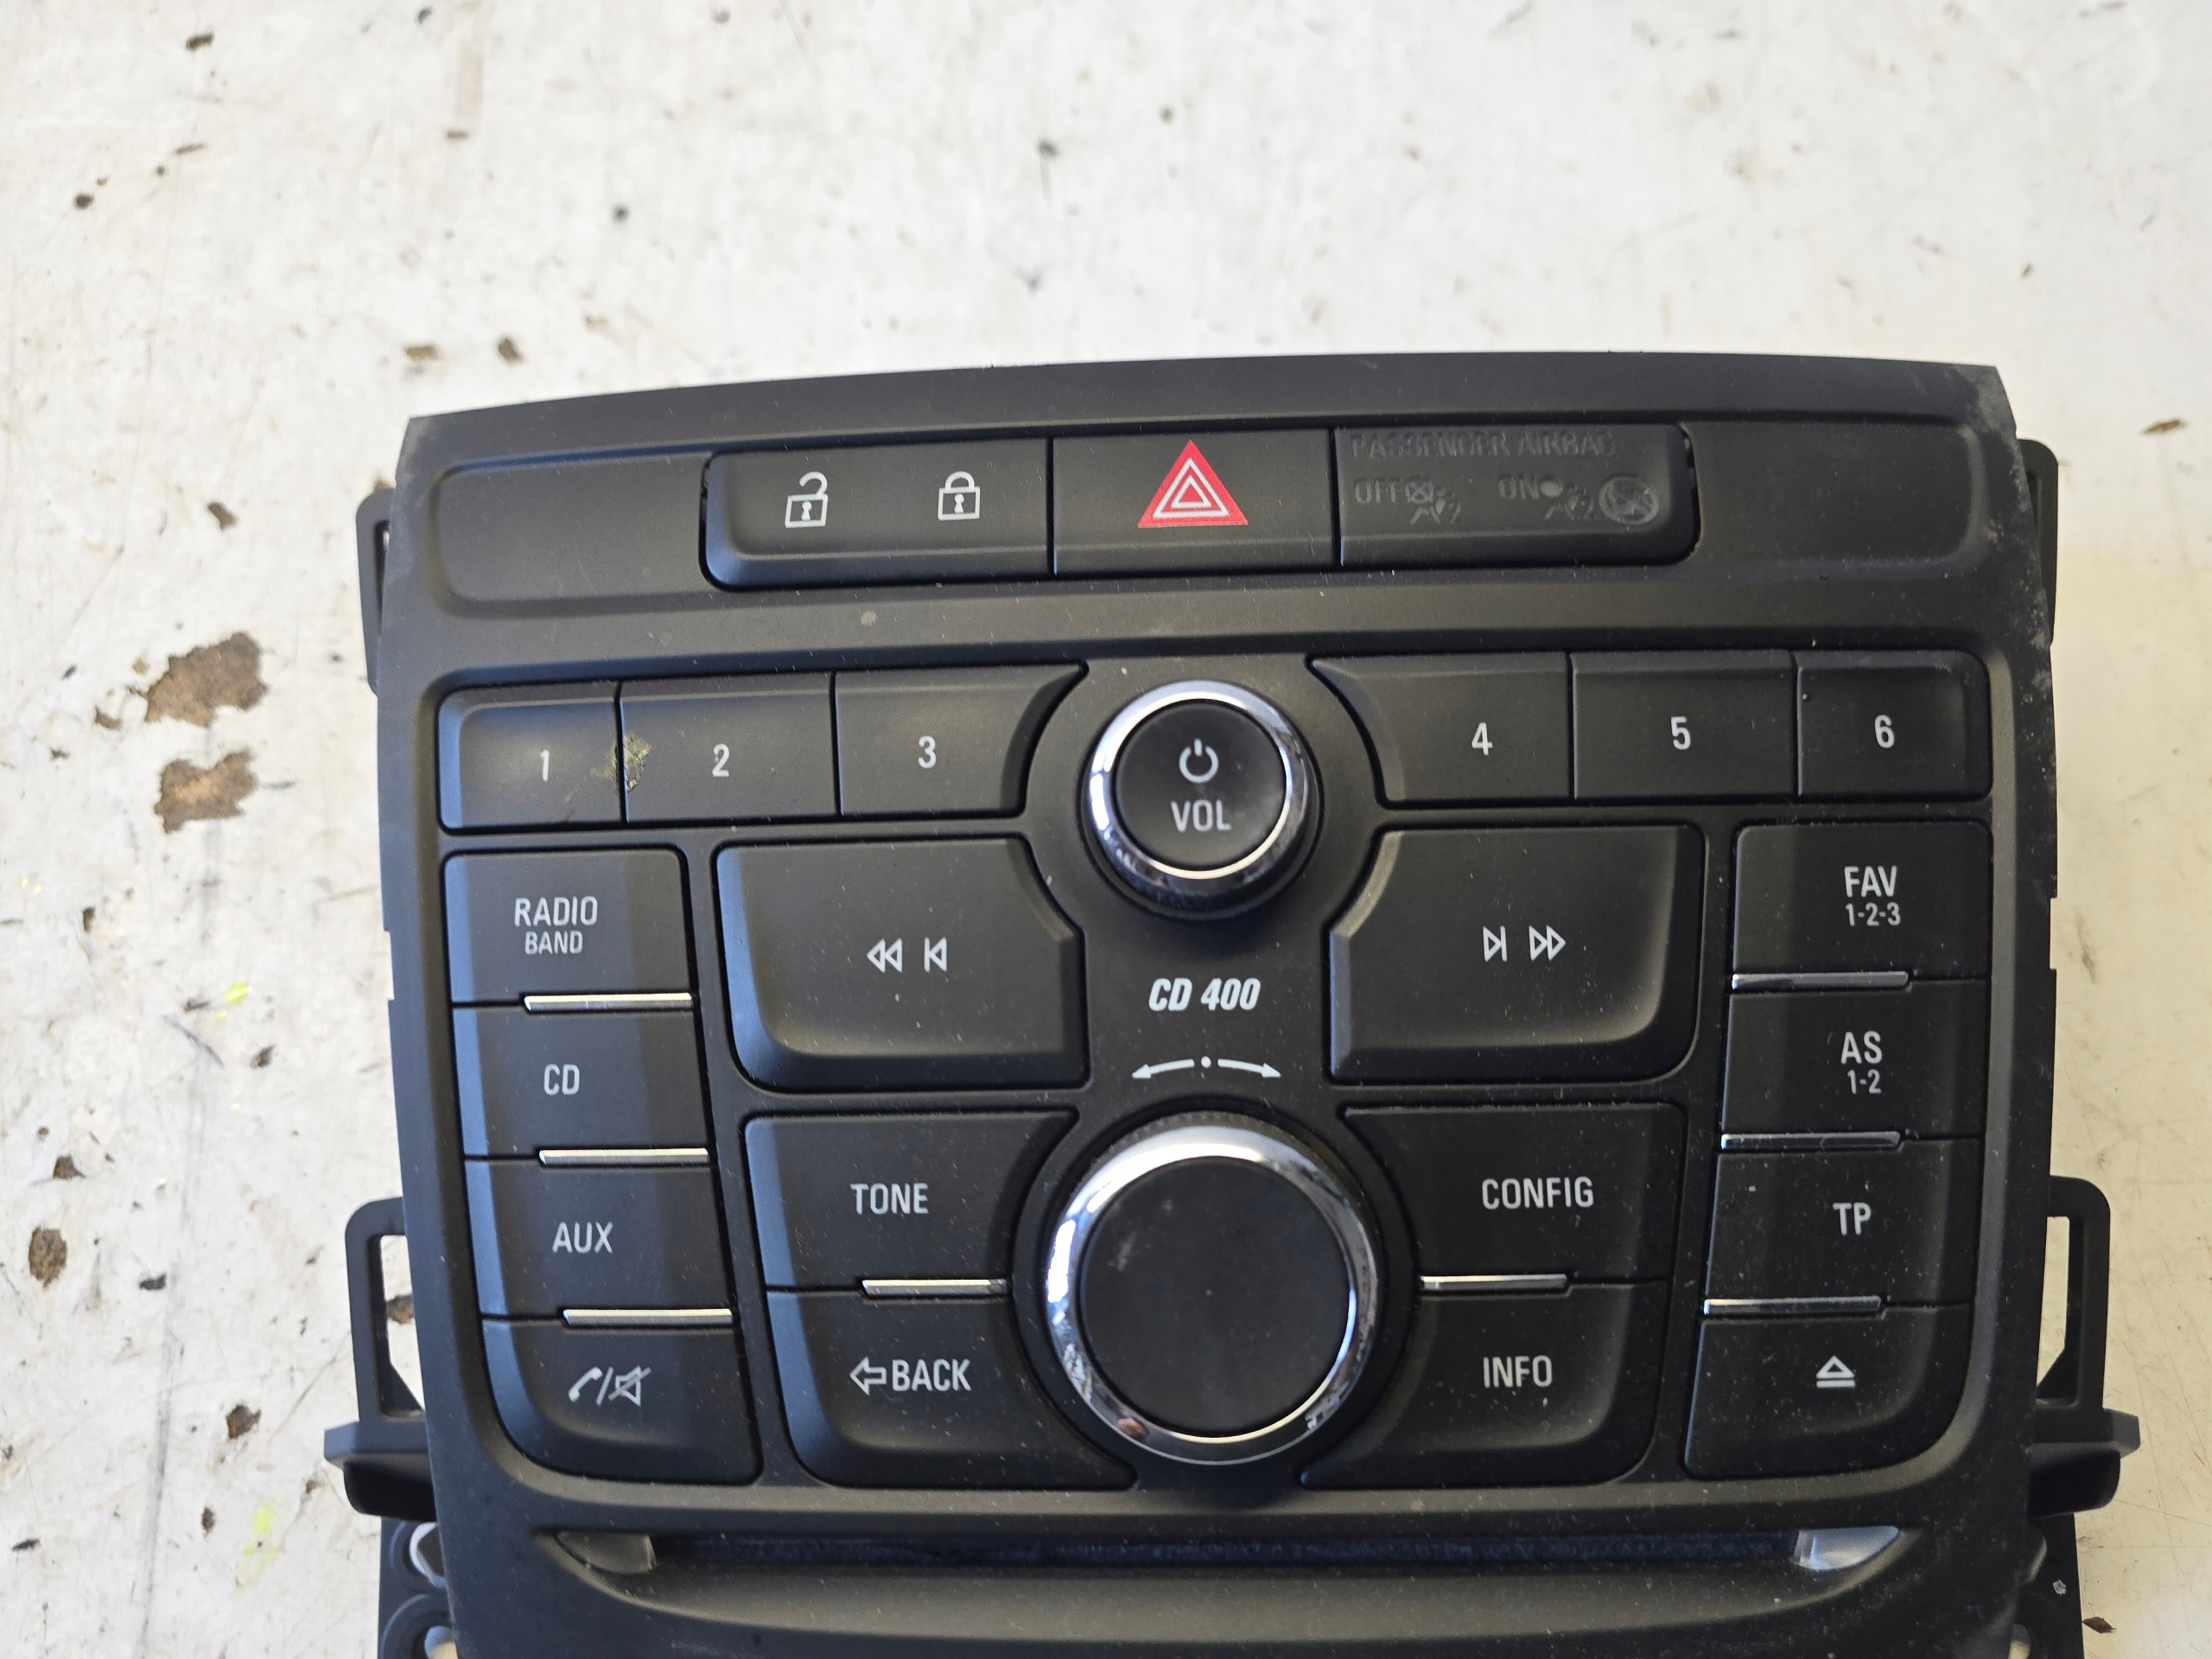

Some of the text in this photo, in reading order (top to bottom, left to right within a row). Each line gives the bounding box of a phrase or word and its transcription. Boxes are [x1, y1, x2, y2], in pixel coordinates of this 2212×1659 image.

[1497, 474, 1540, 500] ON
[1471, 722, 1493, 755] 4
[1671, 716, 1691, 749] 5
[1874, 715, 1895, 747] 6
[540, 750, 550, 780] 1
[711, 744, 731, 777] 2
[918, 736, 937, 768] 3
[1171, 799, 1231, 833] VOL
[1844, 866, 1897, 897] FAV
[514, 895, 598, 927] RADIO
[1845, 903, 1901, 926] 1-2-3
[524, 931, 583, 955] BAND
[1148, 977, 1262, 1011] CD 400
[1840, 1031, 1882, 1065] AS
[543, 1064, 580, 1095] CD
[1847, 1071, 1881, 1094] 1-2
[850, 1183, 928, 1214] TONE
[1481, 1176, 1594, 1210] CONFIG
[1834, 1202, 1872, 1236] TP
[553, 1223, 613, 1254] AUX
[893, 1358, 970, 1392] BACK
[1483, 1355, 1553, 1388] INFO
